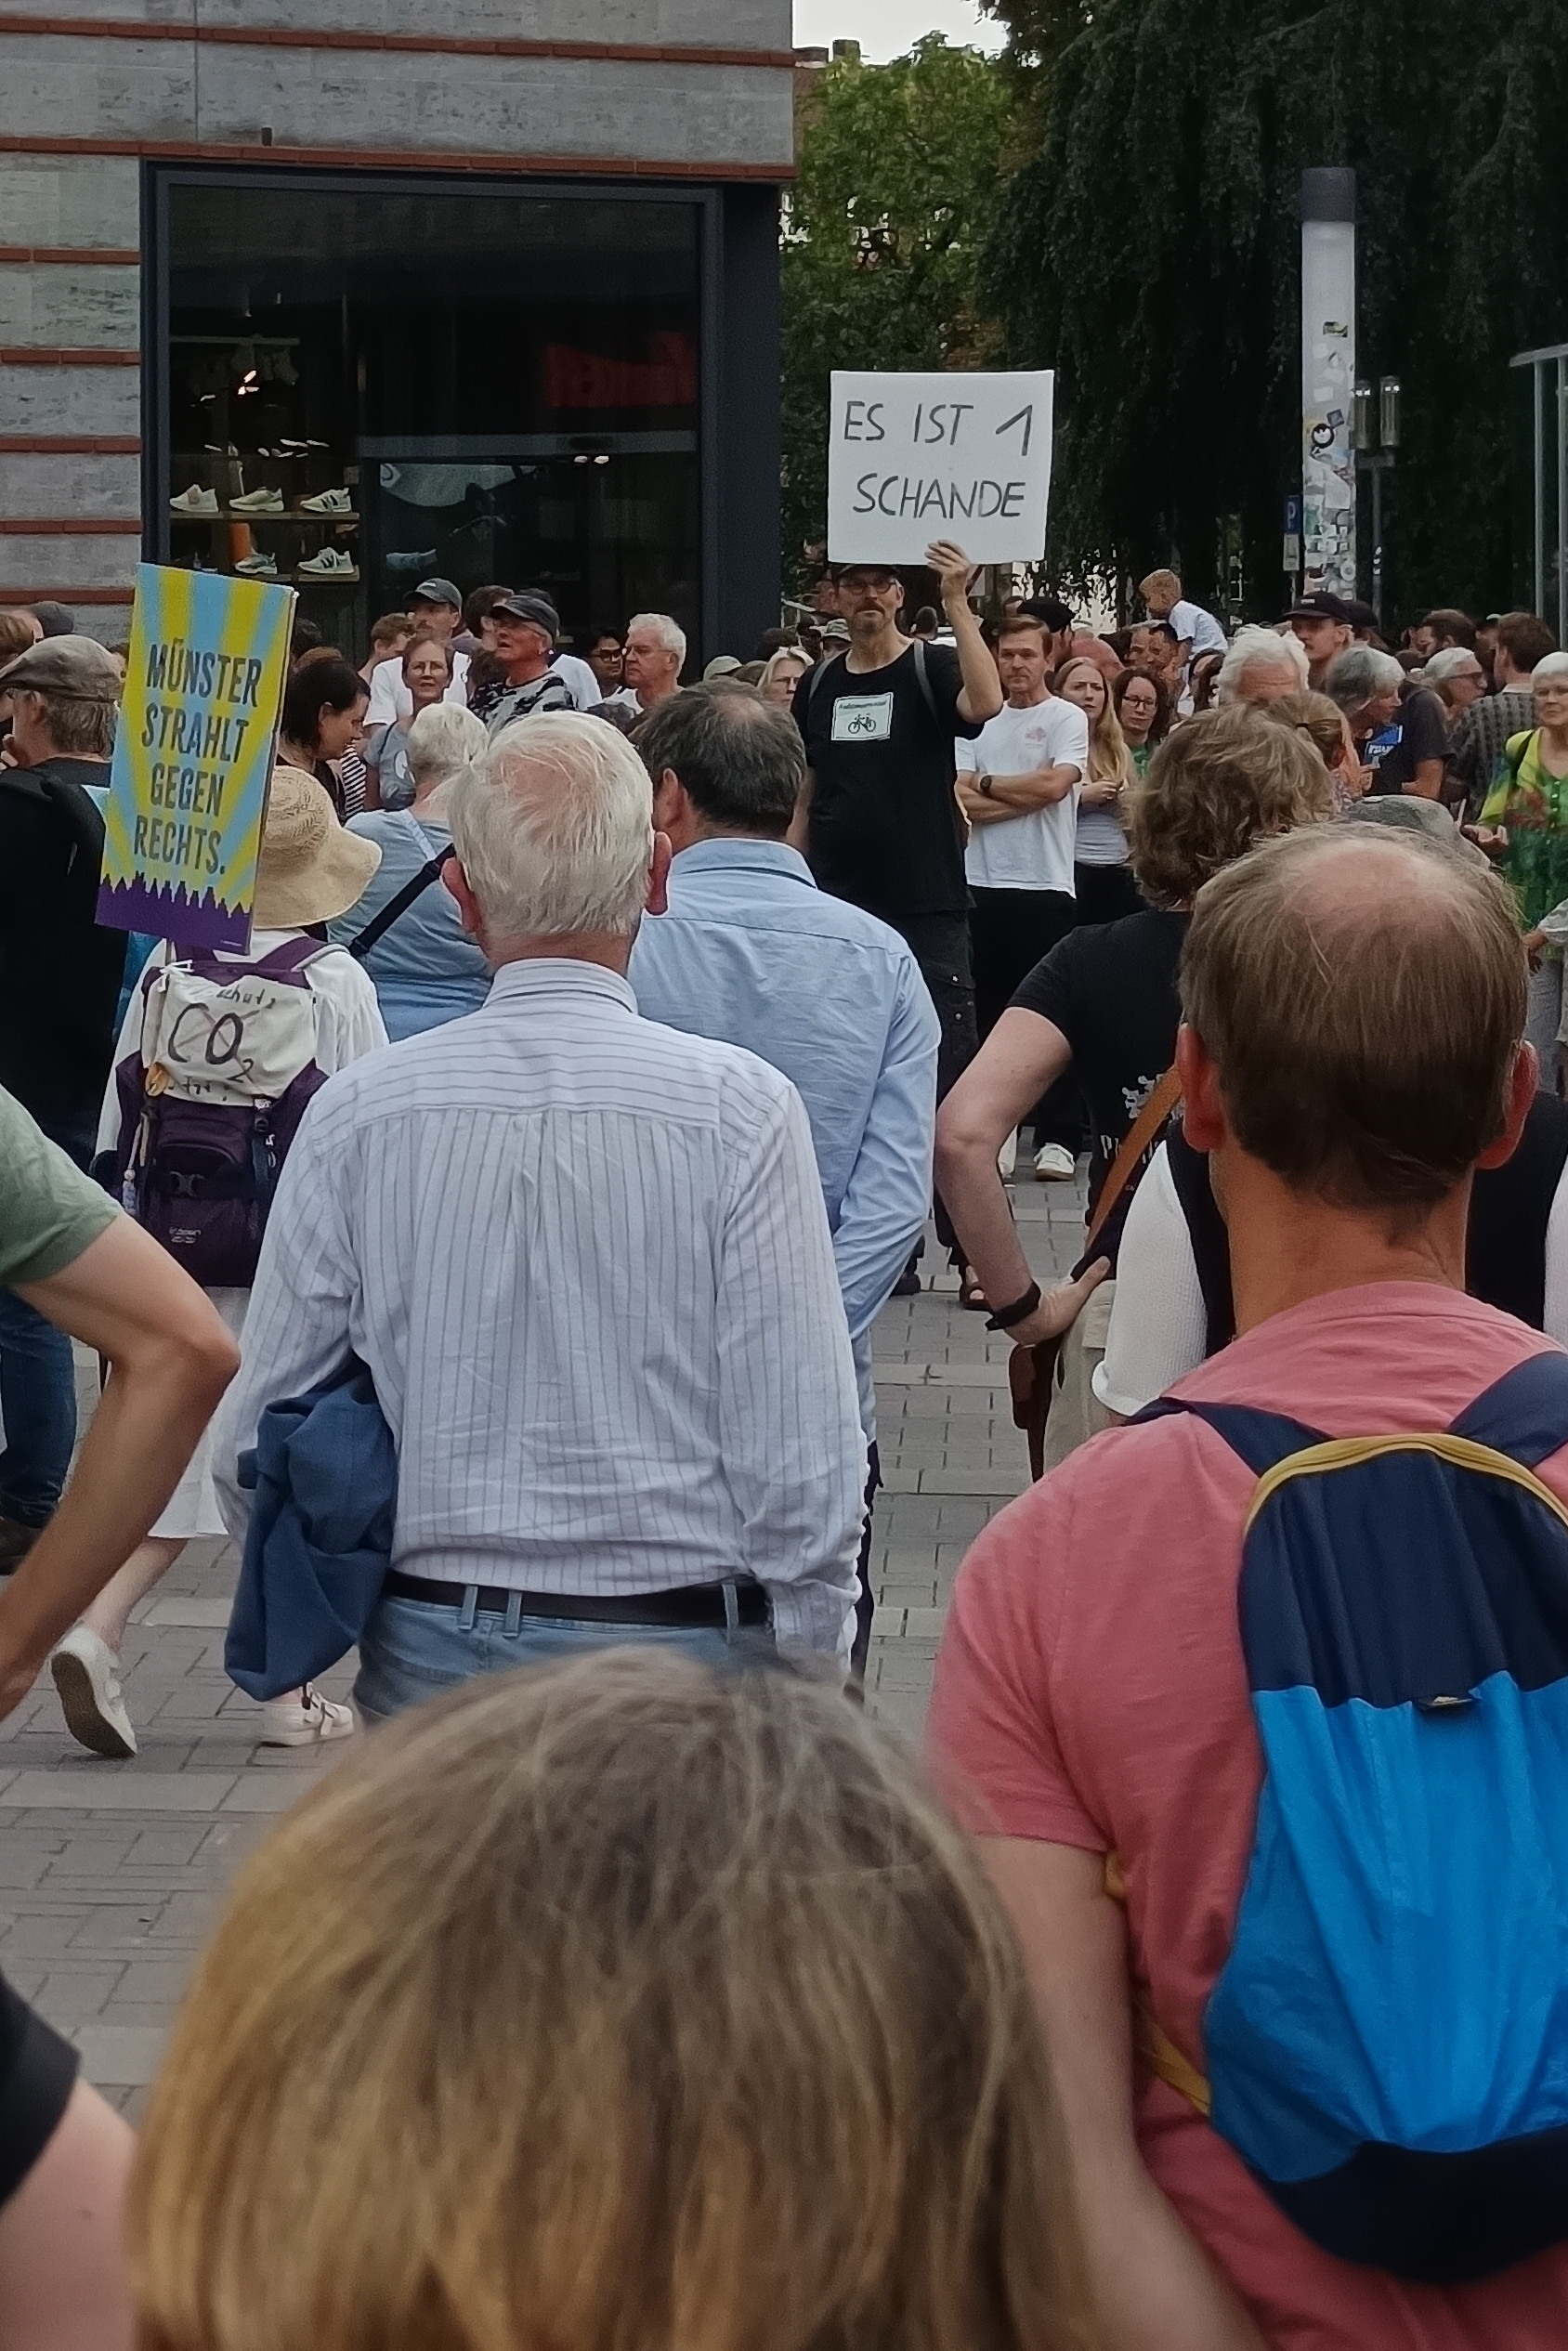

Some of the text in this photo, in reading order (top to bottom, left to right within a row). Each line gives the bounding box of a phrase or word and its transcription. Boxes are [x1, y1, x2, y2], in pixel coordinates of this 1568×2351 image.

[843, 400, 1034, 456] ES IST 1
[852, 472, 1026, 519] SCHANDE
[146, 636, 263, 708] MÜNSTER
[140, 701, 250, 764] STRAHLT
[150, 761, 225, 817] GEGEN
[133, 814, 227, 875] RECHTS.
